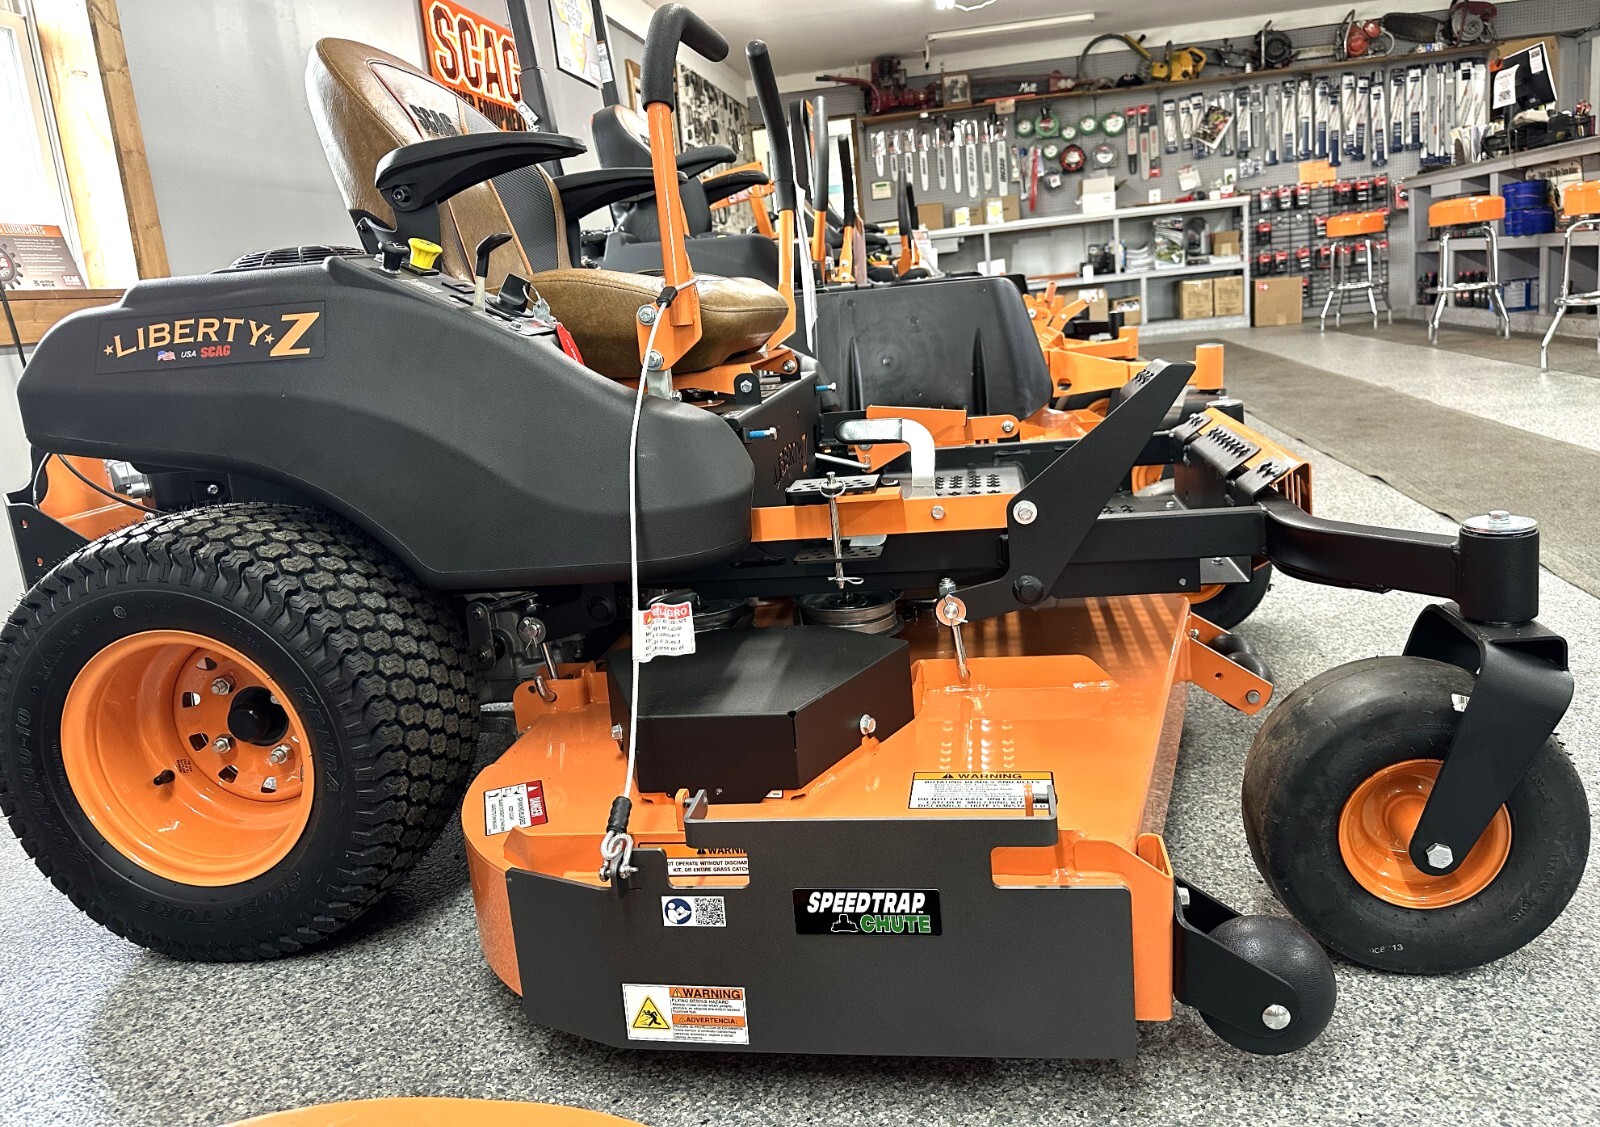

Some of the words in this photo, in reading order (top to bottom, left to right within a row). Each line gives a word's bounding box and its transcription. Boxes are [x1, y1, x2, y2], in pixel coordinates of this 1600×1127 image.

[113, 317, 272, 358] LIBERTY
[269, 311, 320, 357] Z
[181, 350, 197, 359] USA
[200, 345, 231, 358] SCAG
[807, 891, 926, 913] SPEEDTRAP
[859, 914, 931, 933] CHUTE
[683, 989, 740, 999] WARNING
